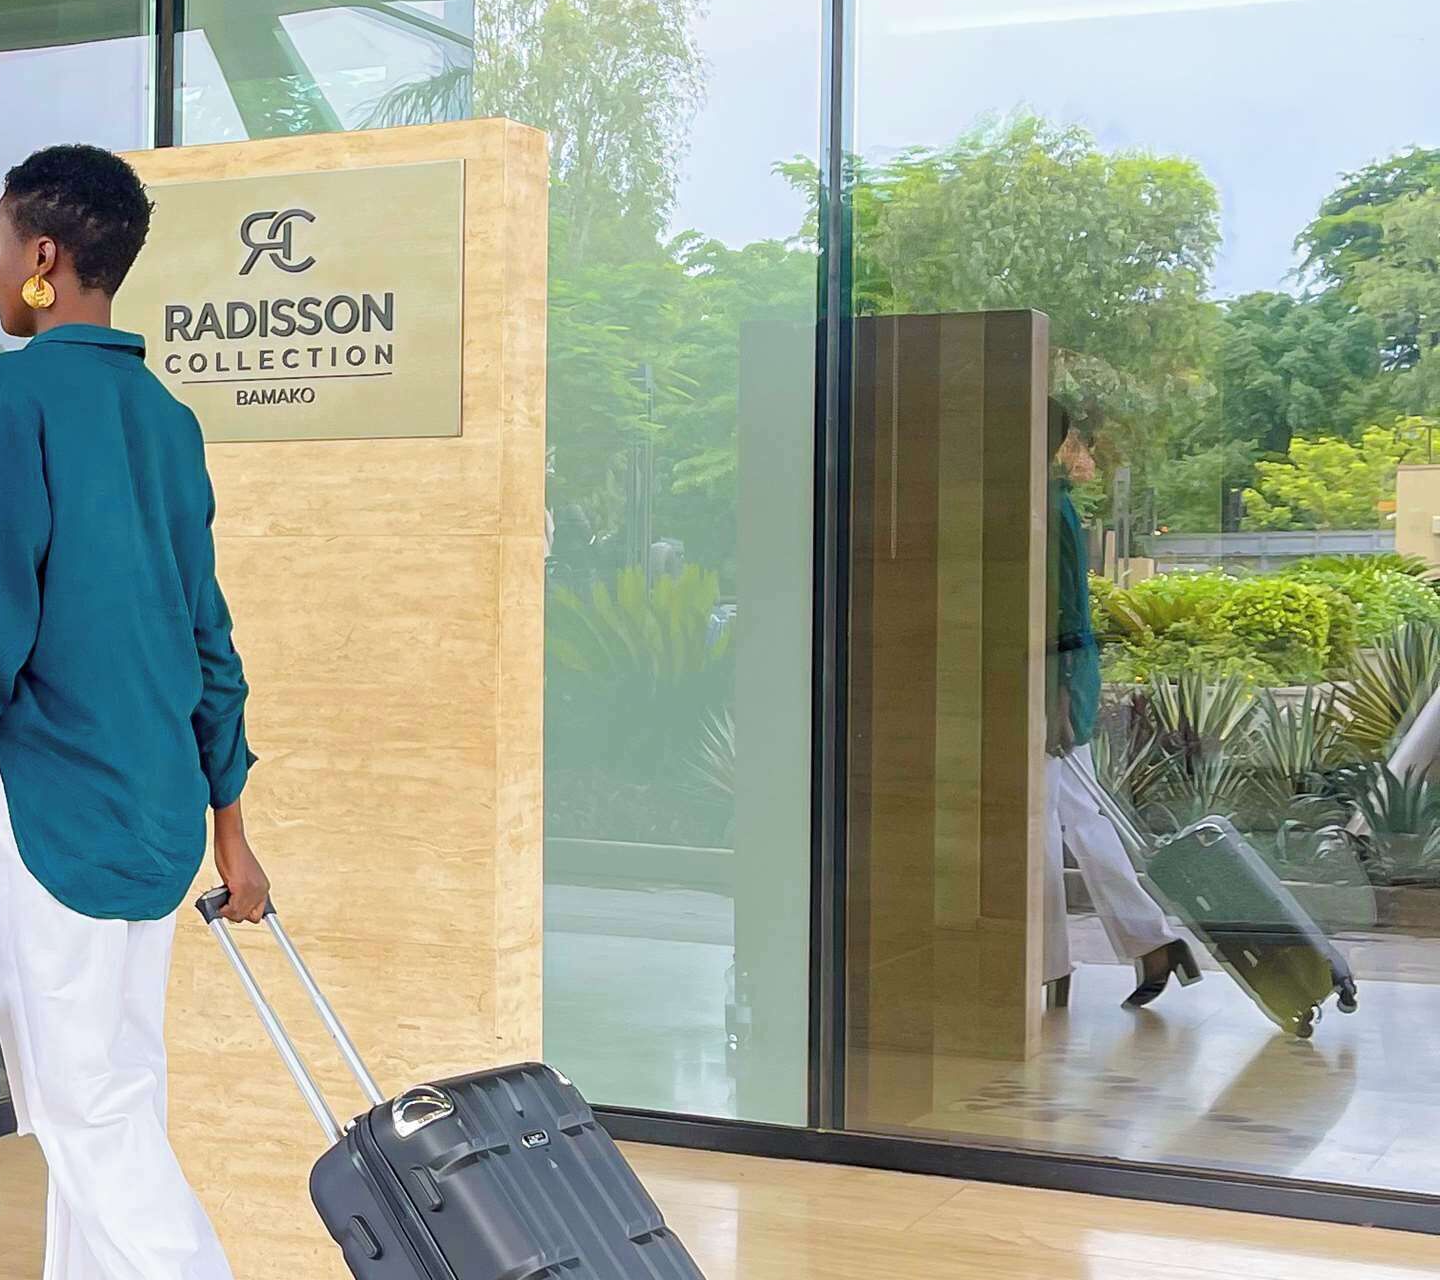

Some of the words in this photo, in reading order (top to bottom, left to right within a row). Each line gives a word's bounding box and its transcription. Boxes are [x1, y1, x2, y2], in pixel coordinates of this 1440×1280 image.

[165, 293, 394, 342] RADISSON
[165, 344, 393, 374] COLLECTION
[236, 387, 315, 406] BAMAKO
